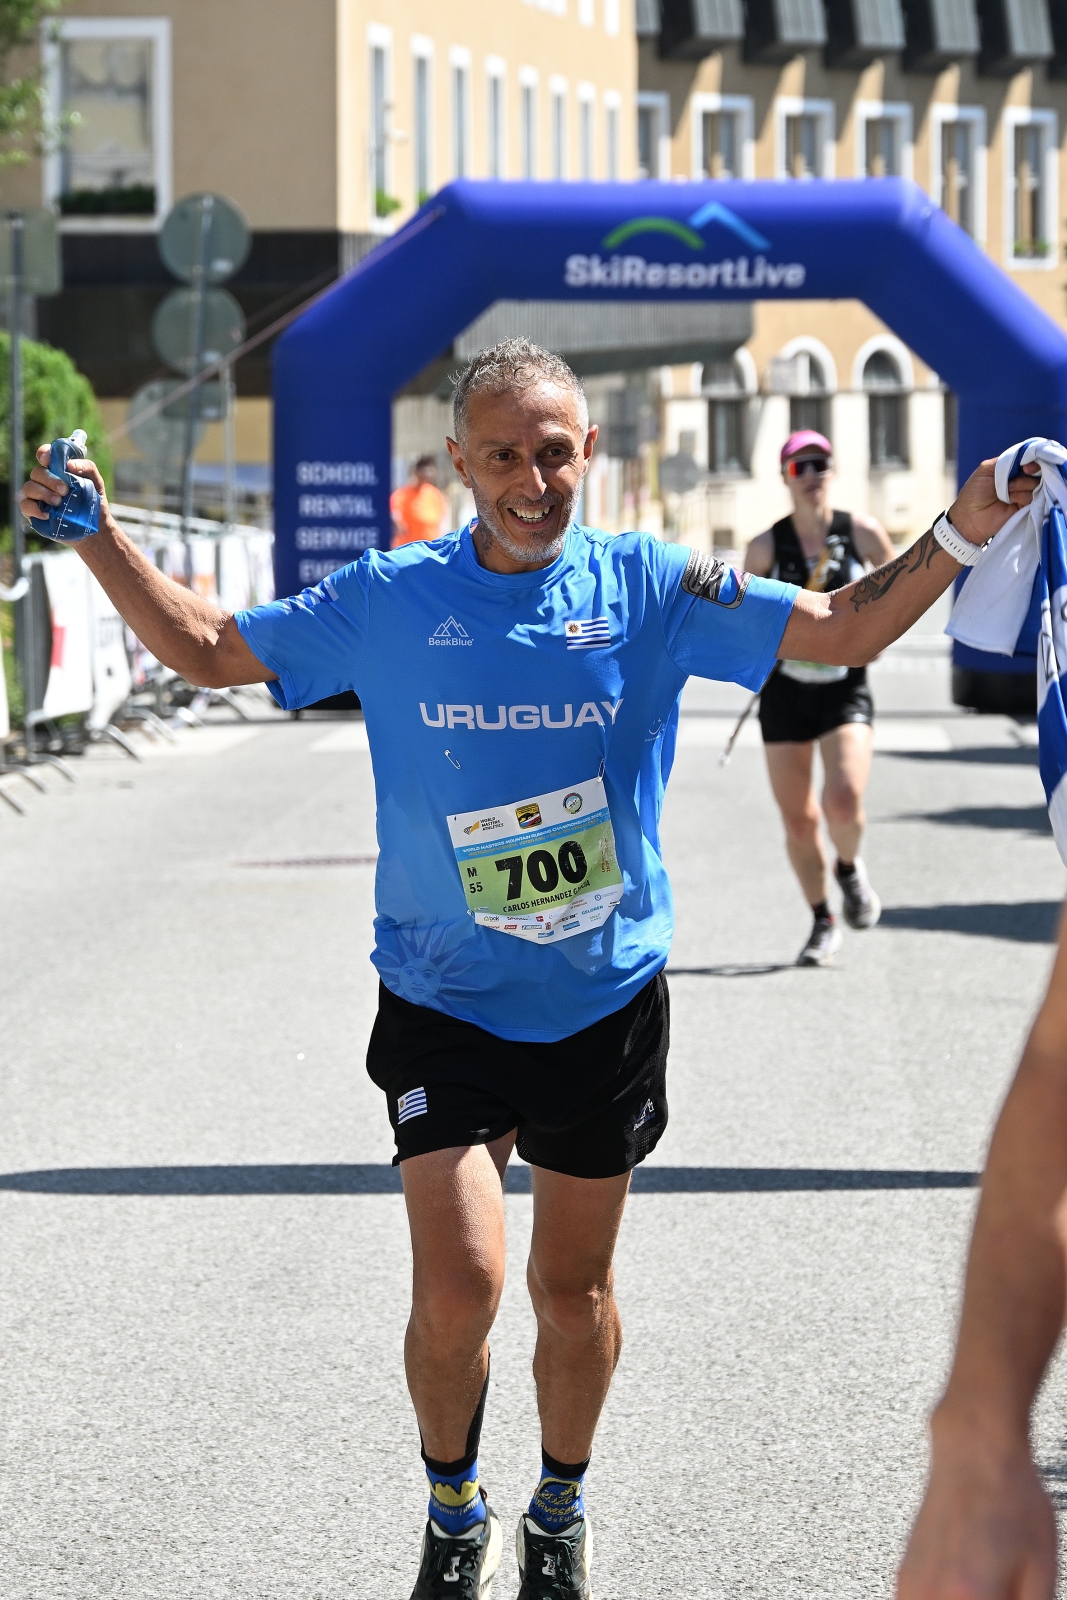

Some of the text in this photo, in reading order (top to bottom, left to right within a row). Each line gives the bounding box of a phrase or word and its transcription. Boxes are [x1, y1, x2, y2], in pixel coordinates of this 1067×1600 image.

[565, 254, 806, 288] SkiResortLive
[296, 461, 378, 486] SCHOOL
[298, 493, 376, 518] RENTAL
[295, 526, 380, 551] SERVICE
[428, 637, 472, 646] BeakBlue
[419, 698, 624, 730] URUGUAY
[480, 816, 496, 824] WORLD
[481, 820, 501, 828] MASTERS
[482, 823, 504, 831] ATHLETICS
[462, 845, 480, 853] WORLD
[480, 840, 505, 850] MASTERS
[505, 834, 531, 845] MOUNTAIN
[467, 867, 478, 878] M
[495, 840, 588, 901] 700
[469, 882, 484, 894] 55
[503, 902, 530, 913] CARLOS
[531, 890, 573, 908] HERNANDEZ
